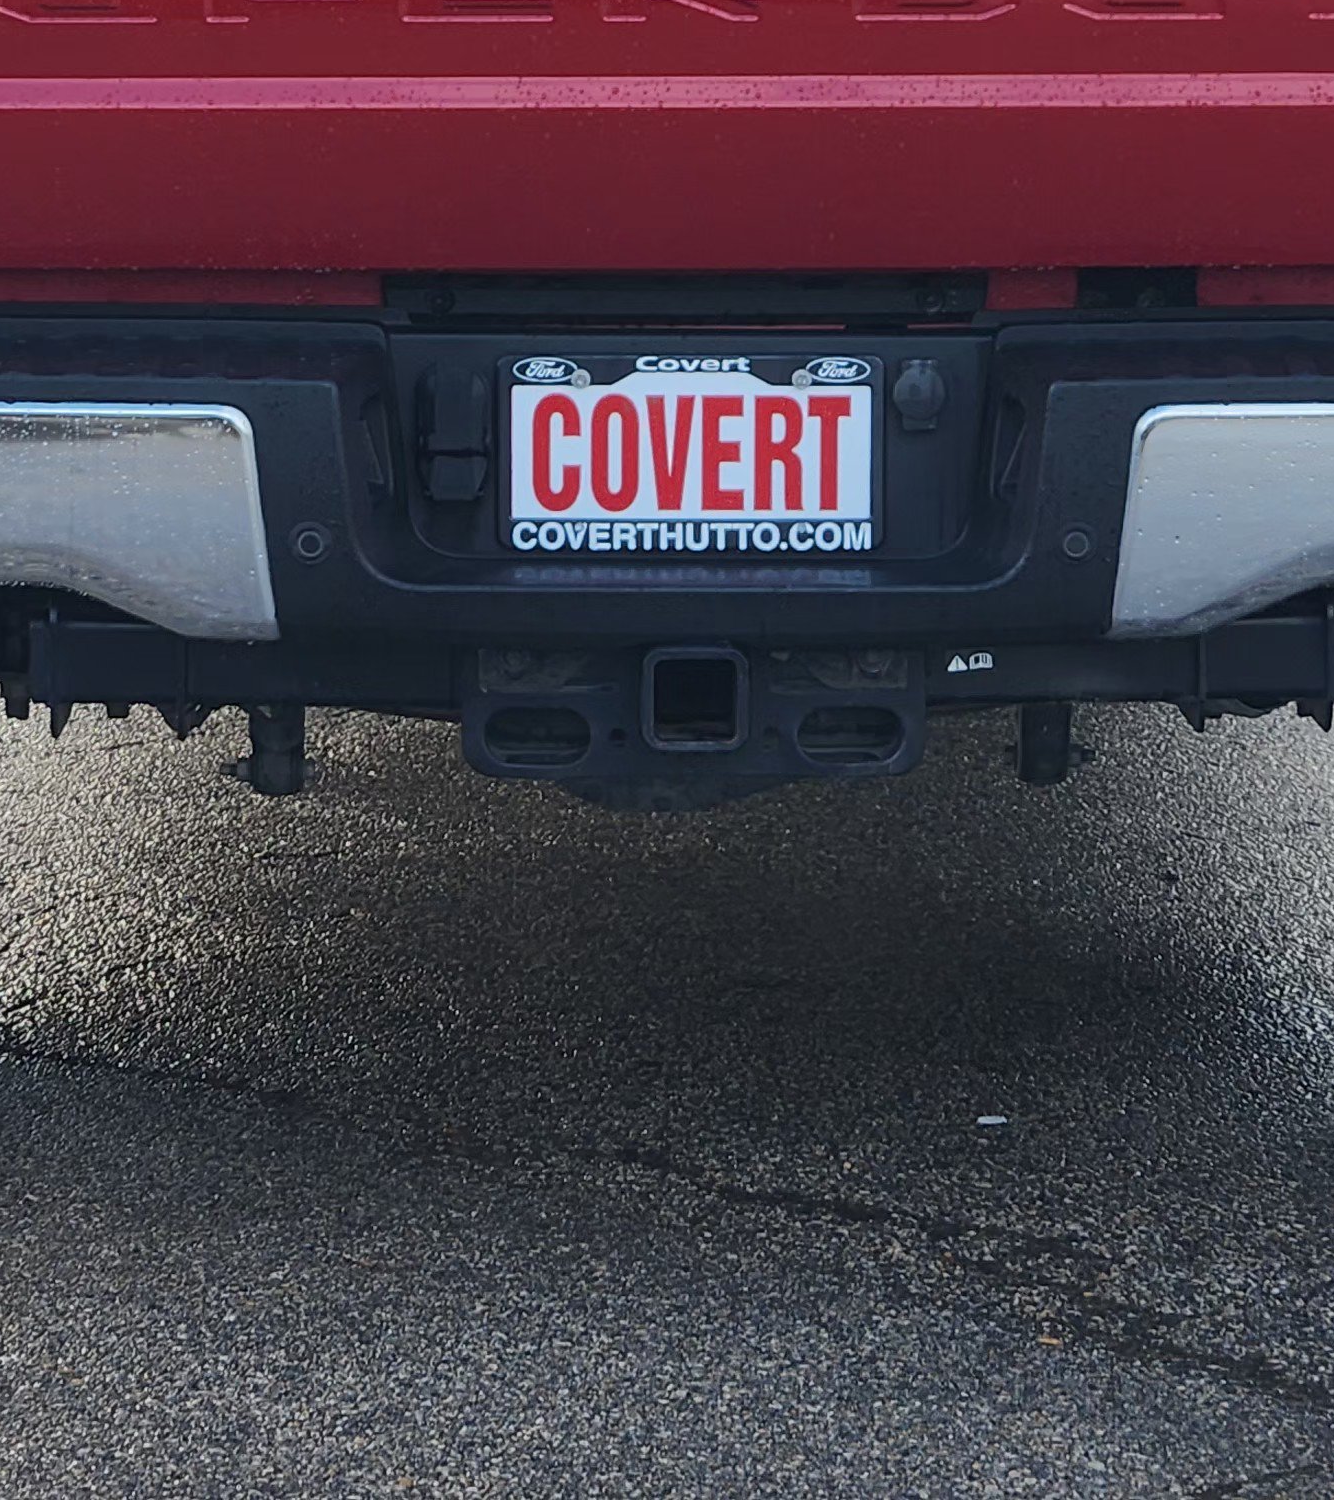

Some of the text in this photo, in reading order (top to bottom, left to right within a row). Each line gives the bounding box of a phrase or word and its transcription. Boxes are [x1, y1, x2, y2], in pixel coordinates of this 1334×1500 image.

[635, 355, 751, 373] Covert
[532, 393, 852, 512] COVERT
[512, 521, 872, 552] COVERTHUTTO.COM
